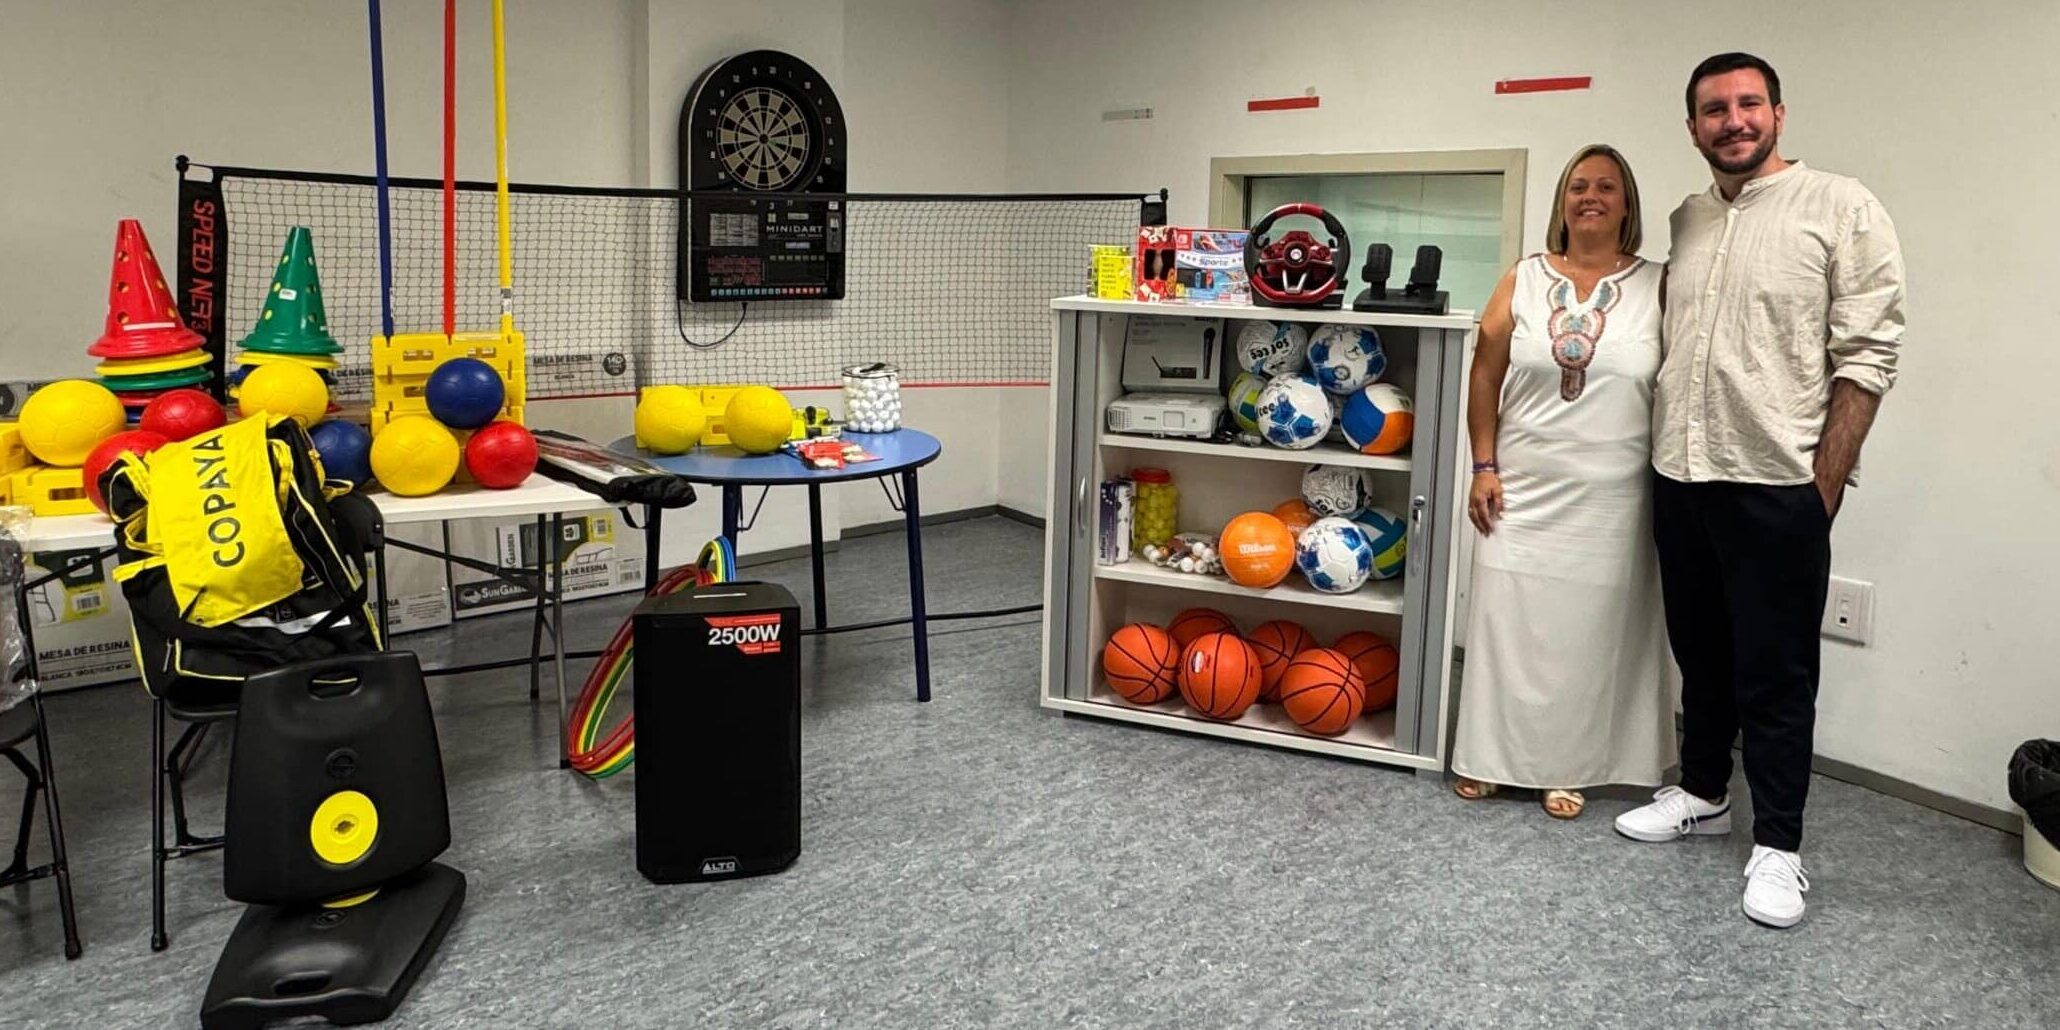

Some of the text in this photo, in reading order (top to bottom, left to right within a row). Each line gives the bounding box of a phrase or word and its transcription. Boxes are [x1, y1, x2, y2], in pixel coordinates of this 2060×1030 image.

[192, 200, 215, 273] SPEED
[766, 225, 823, 233] MINIDART
[191, 434, 245, 567] COPAYA
[580, 563, 608, 573] RESINA
[708, 624, 780, 645] 2500W
[39, 640, 131, 661] MESA DE RESINA
[702, 862, 736, 873] ALTO
